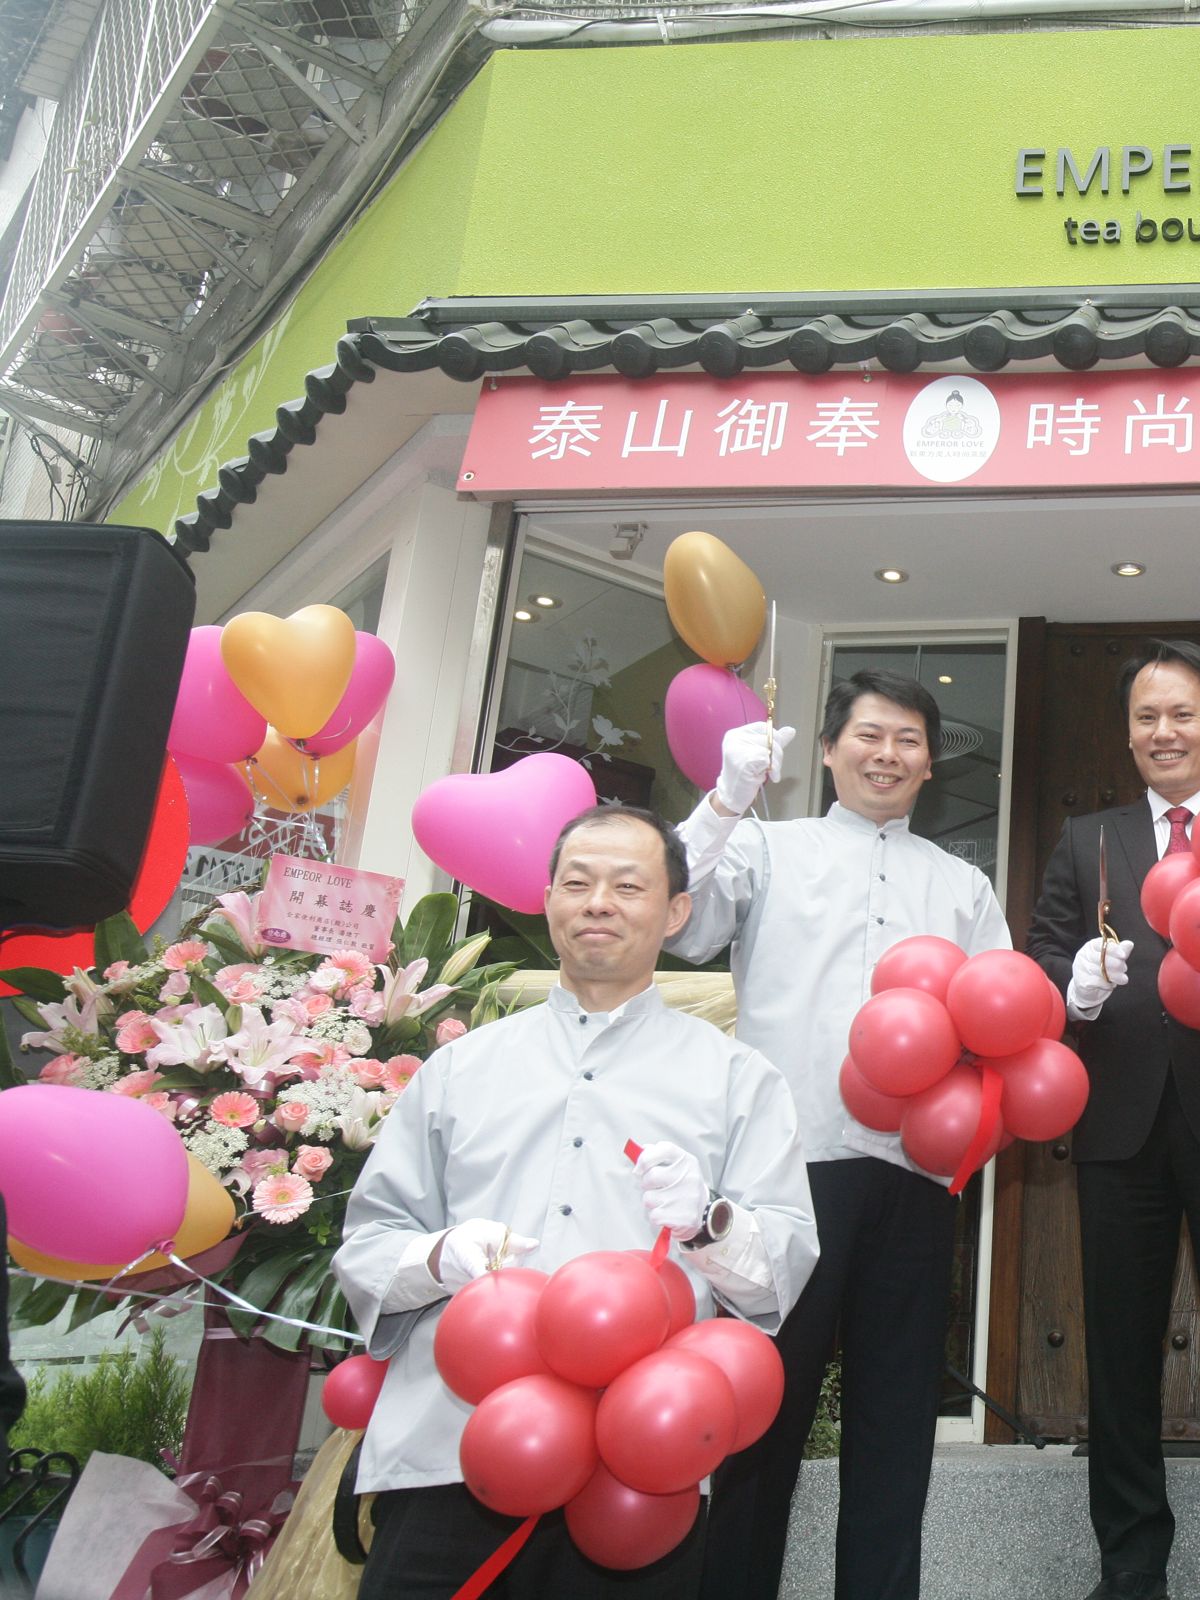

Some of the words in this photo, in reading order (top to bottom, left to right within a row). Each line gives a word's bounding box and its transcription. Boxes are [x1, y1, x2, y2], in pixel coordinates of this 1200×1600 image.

[1064, 214, 1121, 244] tea
[528, 396, 880, 460] 泰山御奉
[916, 440, 958, 448] EMPEROR
[962, 440, 985, 448] LOVE
[283, 867, 322, 883] EMPEOR
[327, 875, 353, 889] LOVE
[289, 890, 377, 919] 開幕誌慶
